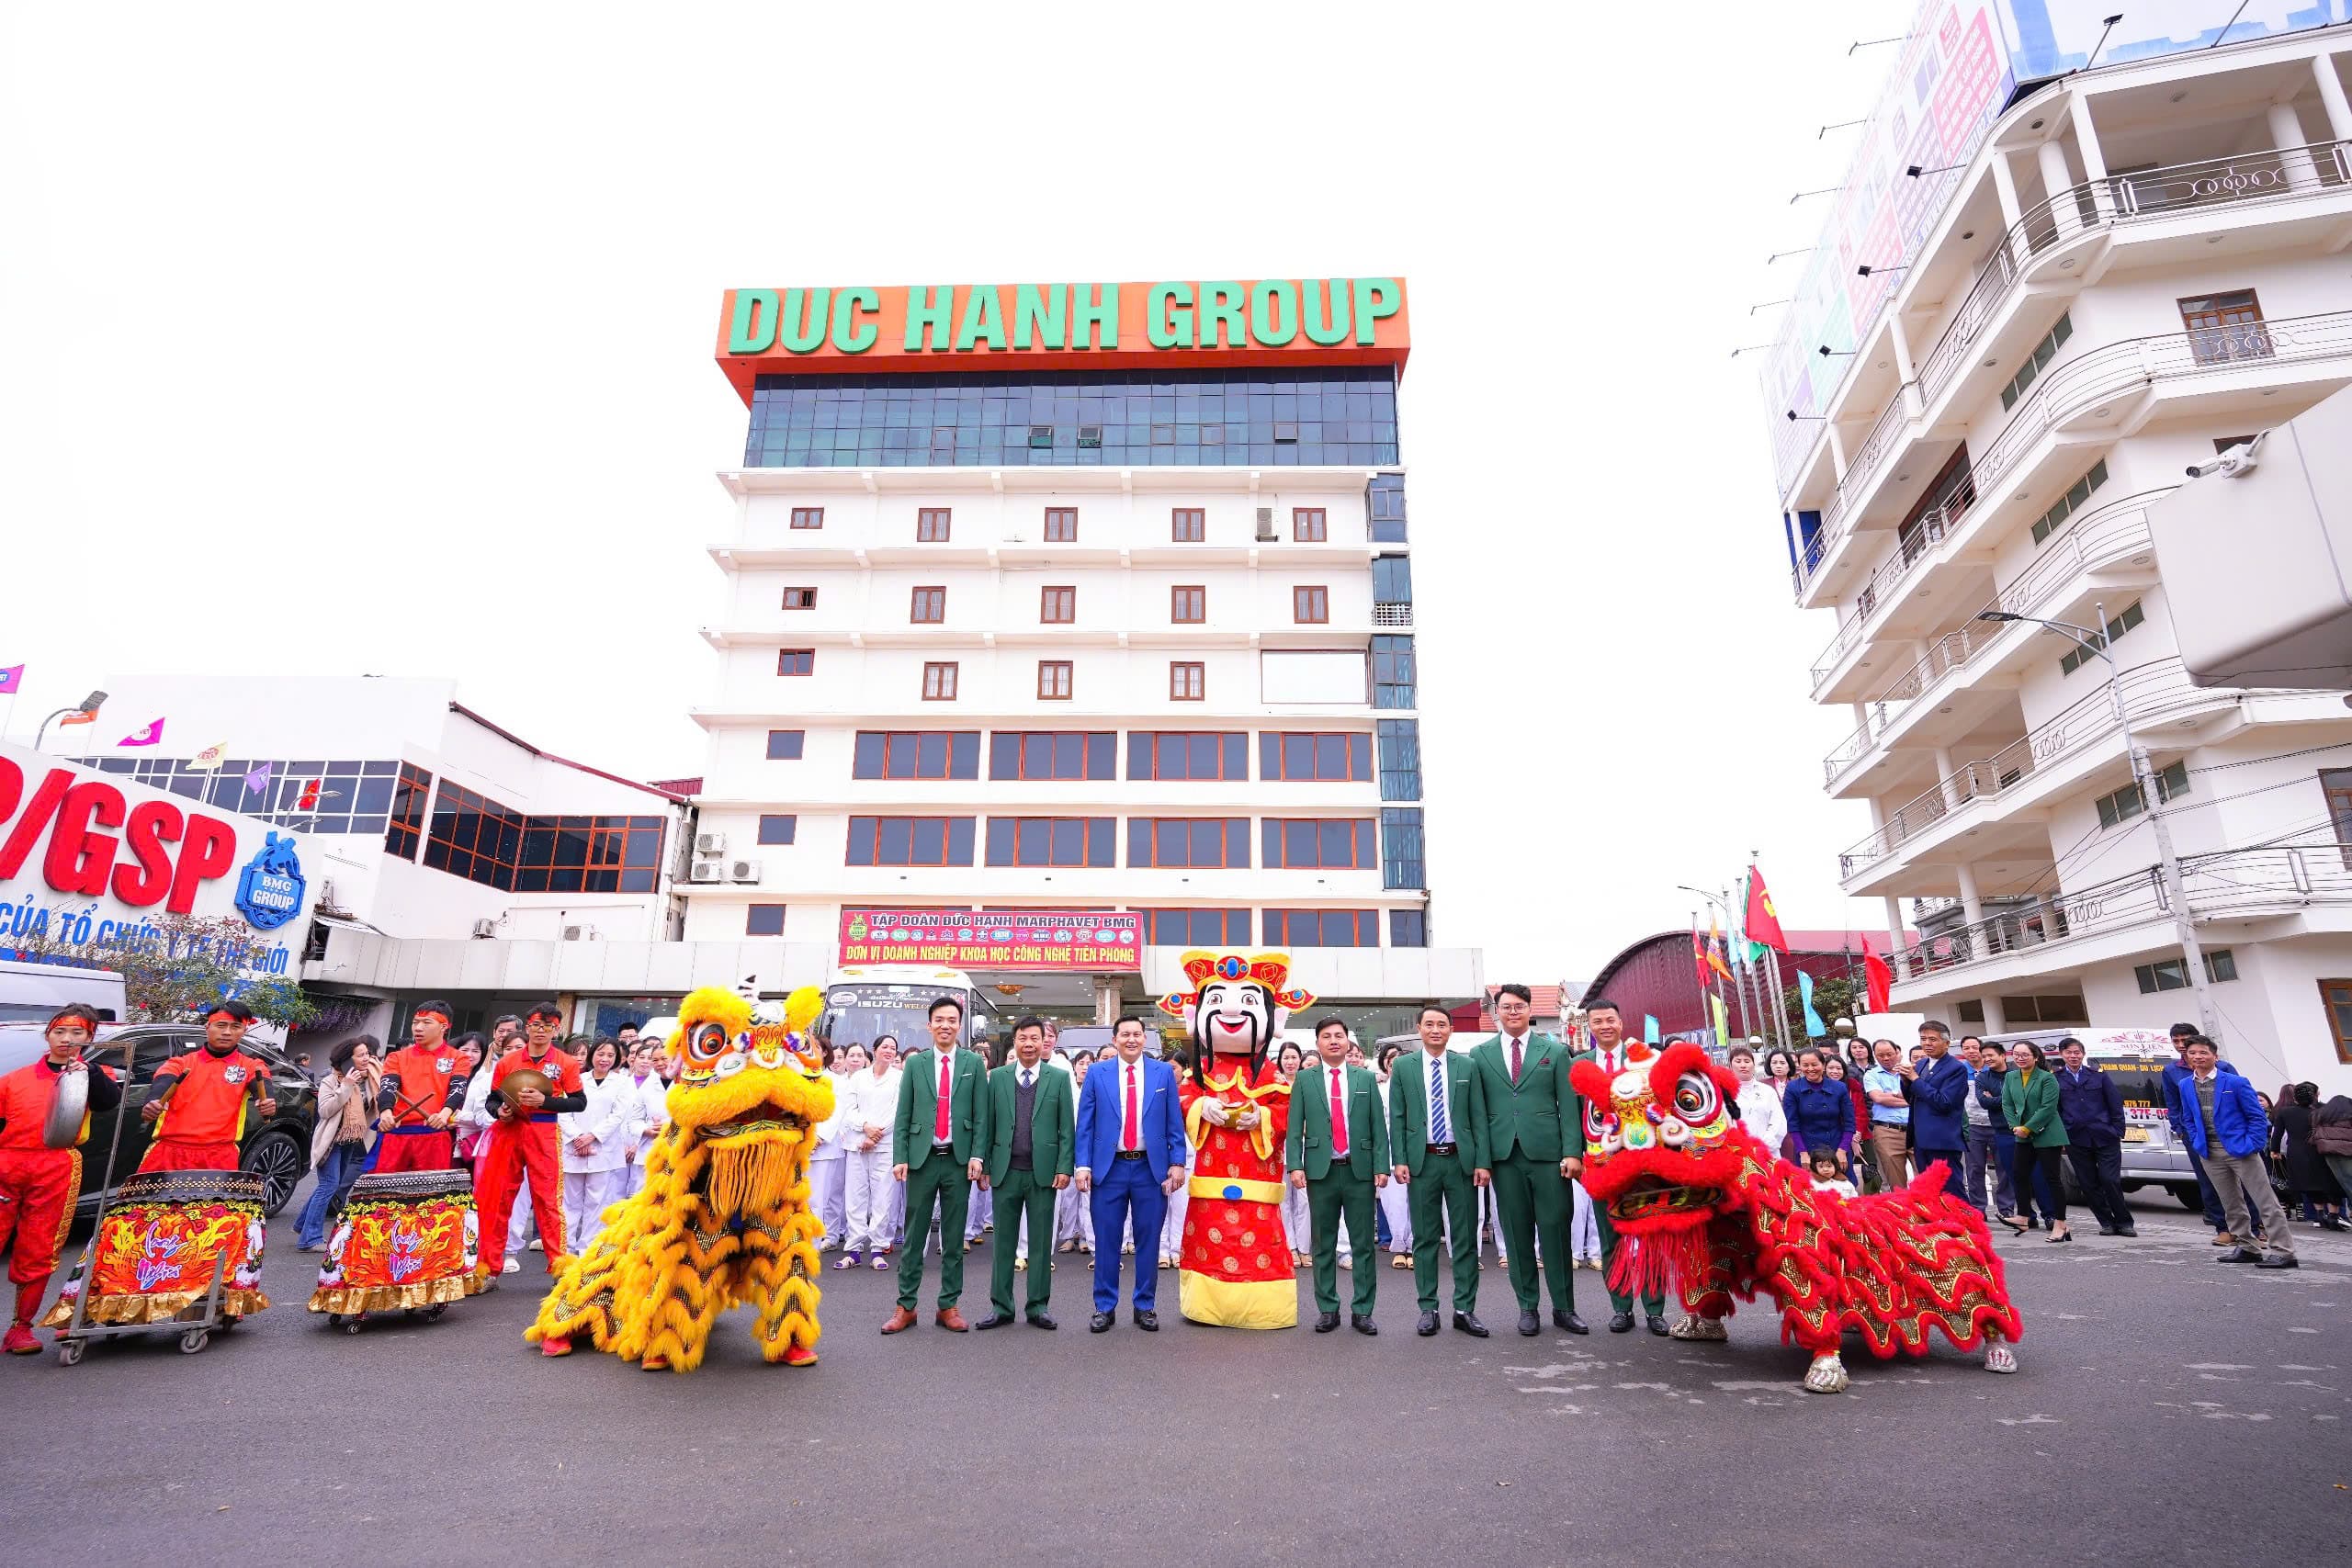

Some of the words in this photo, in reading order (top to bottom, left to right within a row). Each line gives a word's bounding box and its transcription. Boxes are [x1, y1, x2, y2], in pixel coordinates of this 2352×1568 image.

[728, 287, 879, 355] DUC
[904, 283, 1120, 353] HANH
[1148, 277, 1402, 348] GROUP
[262, 876, 292, 892] BMG
[253, 889, 295, 910] GROUP
[59, 903, 98, 946] TỔ
[871, 913, 898, 928] TẬP
[900, 913, 939, 926] ĐOÀN
[943, 913, 971, 926] ĐỨC
[974, 916, 1012, 929] HẠNH
[1016, 916, 1101, 928] MARPHAVET
[1102, 917, 1136, 928] BMG
[871, 946, 881, 963] VỊ
[883, 946, 917, 960] DOANH
[920, 943, 957, 964] NGHIỆP
[960, 946, 987, 961] KHOA
[989, 947, 1011, 964] HỌC
[1013, 944, 1041, 962] CÔNG
[1100, 947, 1135, 963] PHONG
[857, 1000, 902, 1009] ISUZU
